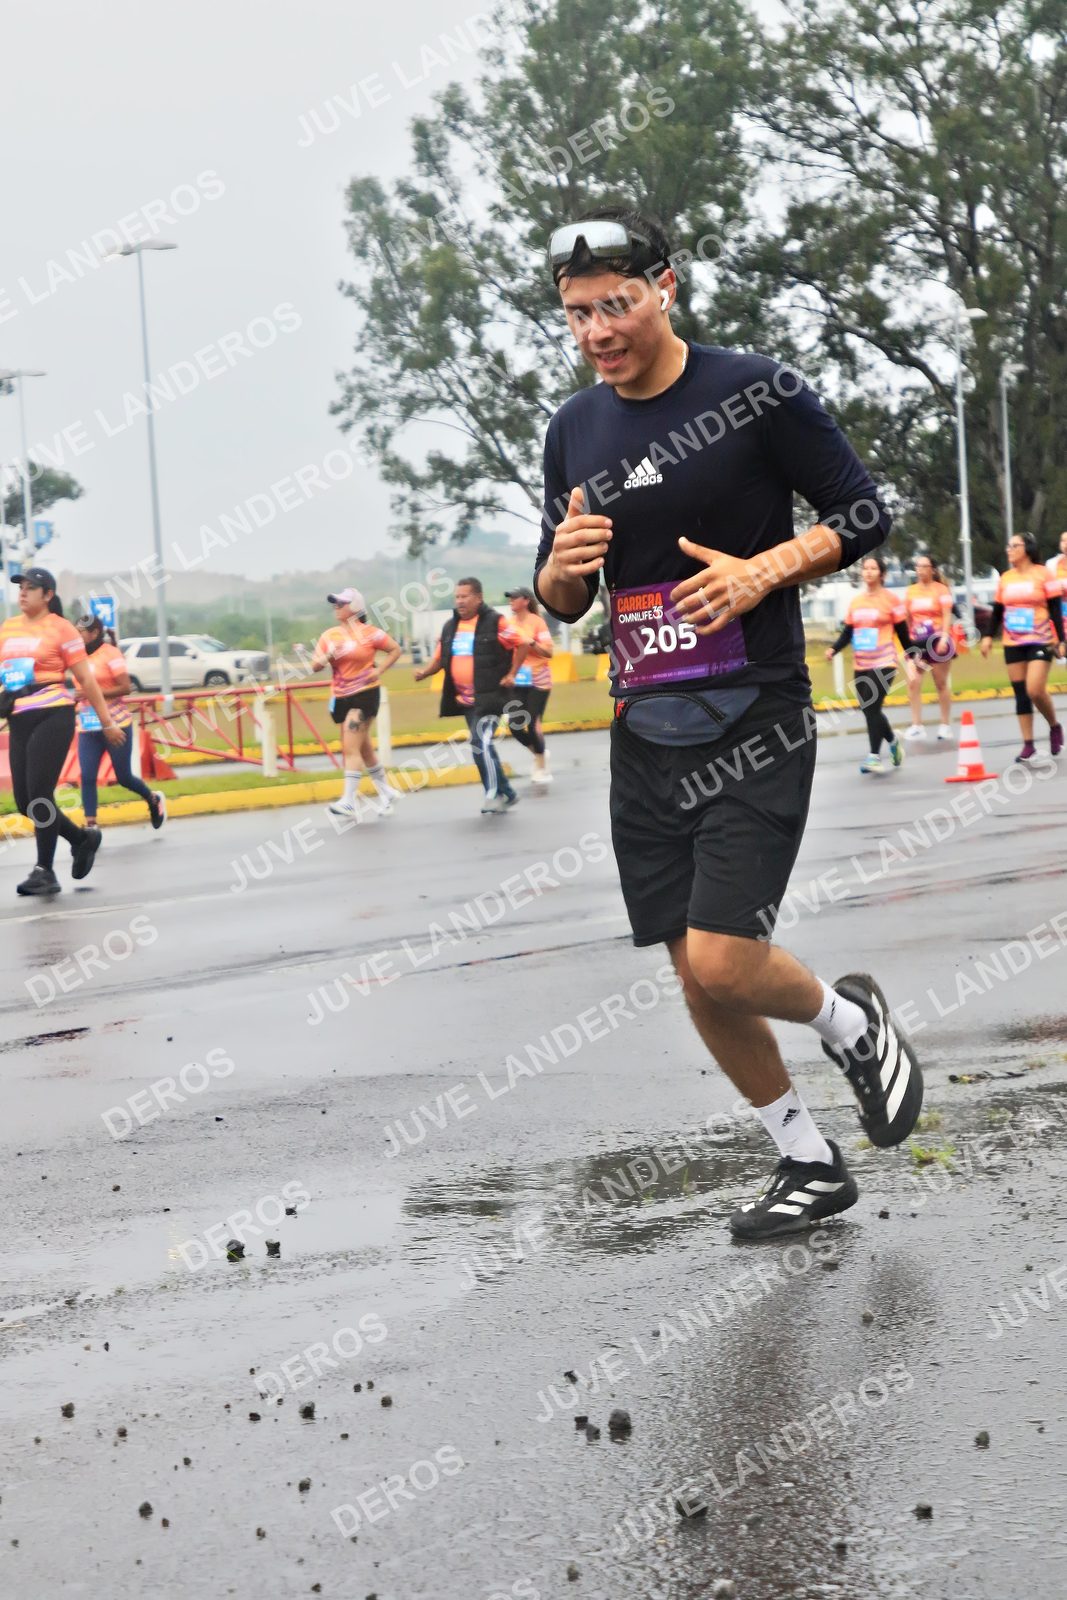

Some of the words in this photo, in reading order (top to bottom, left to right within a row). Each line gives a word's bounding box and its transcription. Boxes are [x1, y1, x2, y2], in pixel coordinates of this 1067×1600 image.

[624, 474, 663, 489] adidas
[617, 592, 663, 613] CARRERA
[641, 622, 698, 655] 205
